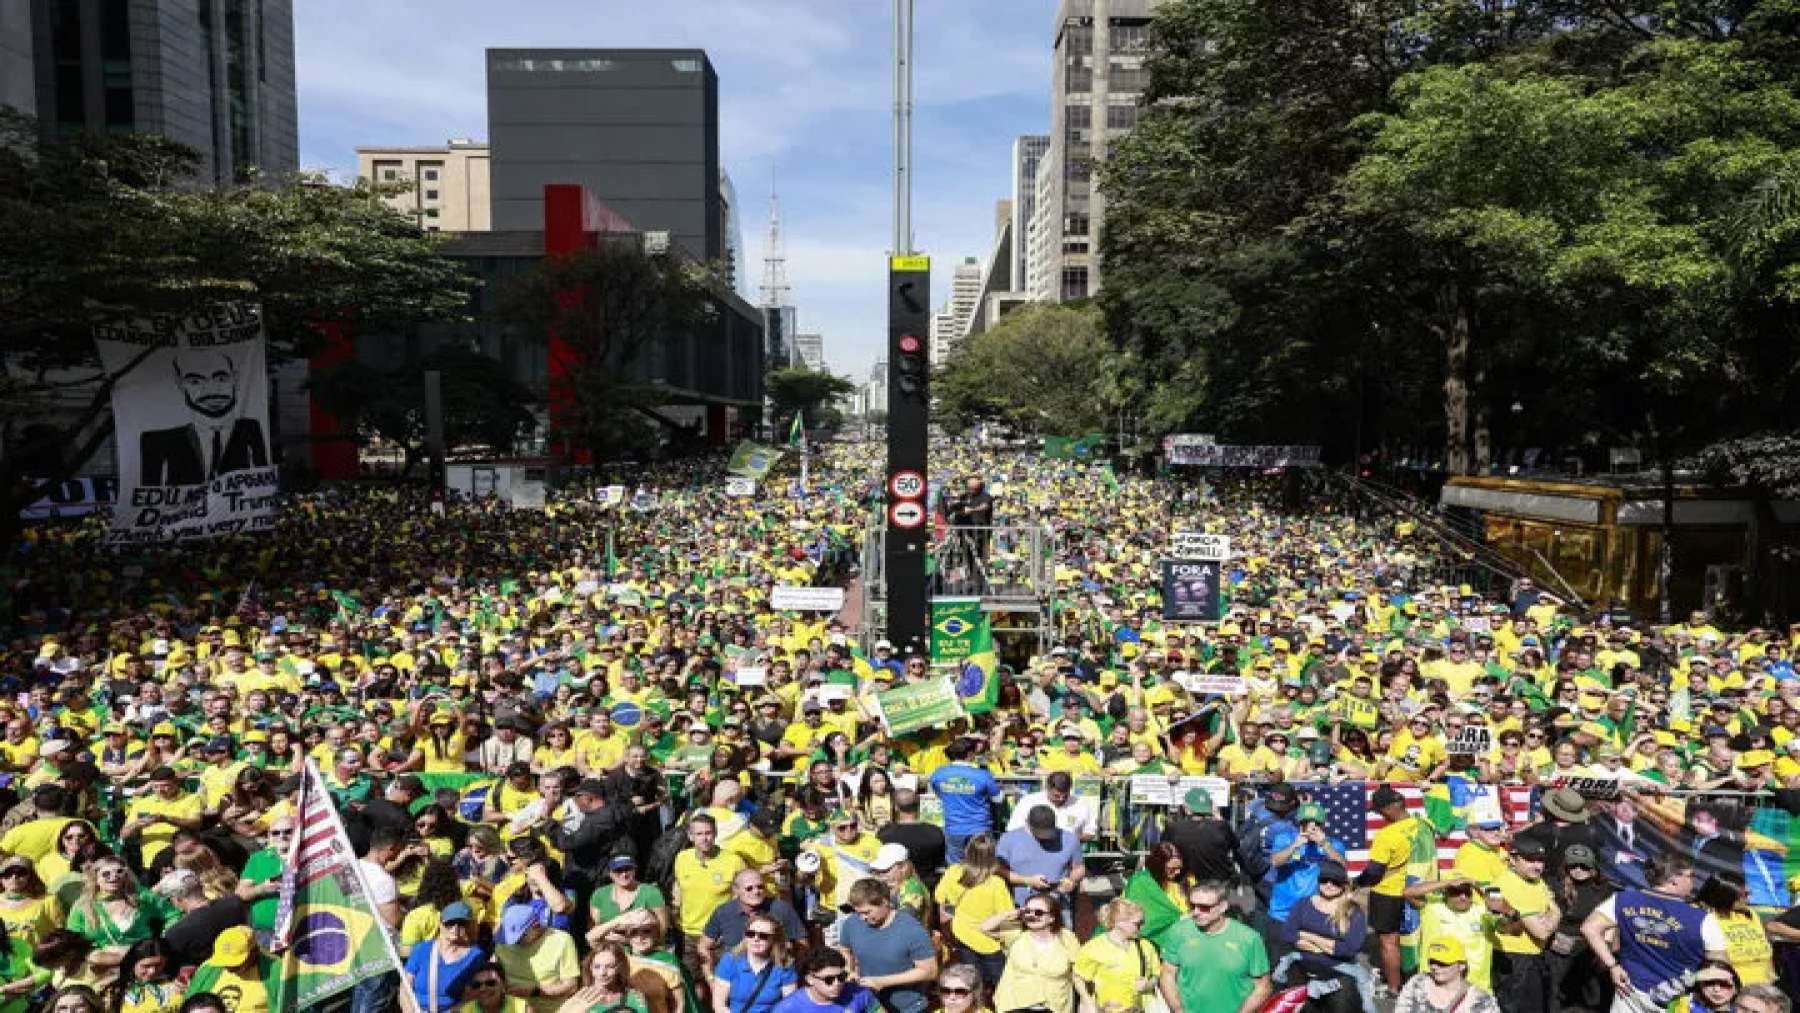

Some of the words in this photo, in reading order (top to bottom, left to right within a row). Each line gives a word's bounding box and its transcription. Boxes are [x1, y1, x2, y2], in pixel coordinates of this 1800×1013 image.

[897, 477, 917, 492] 50
[132, 487, 180, 506] EDU
[1172, 565, 1213, 577] FORA
